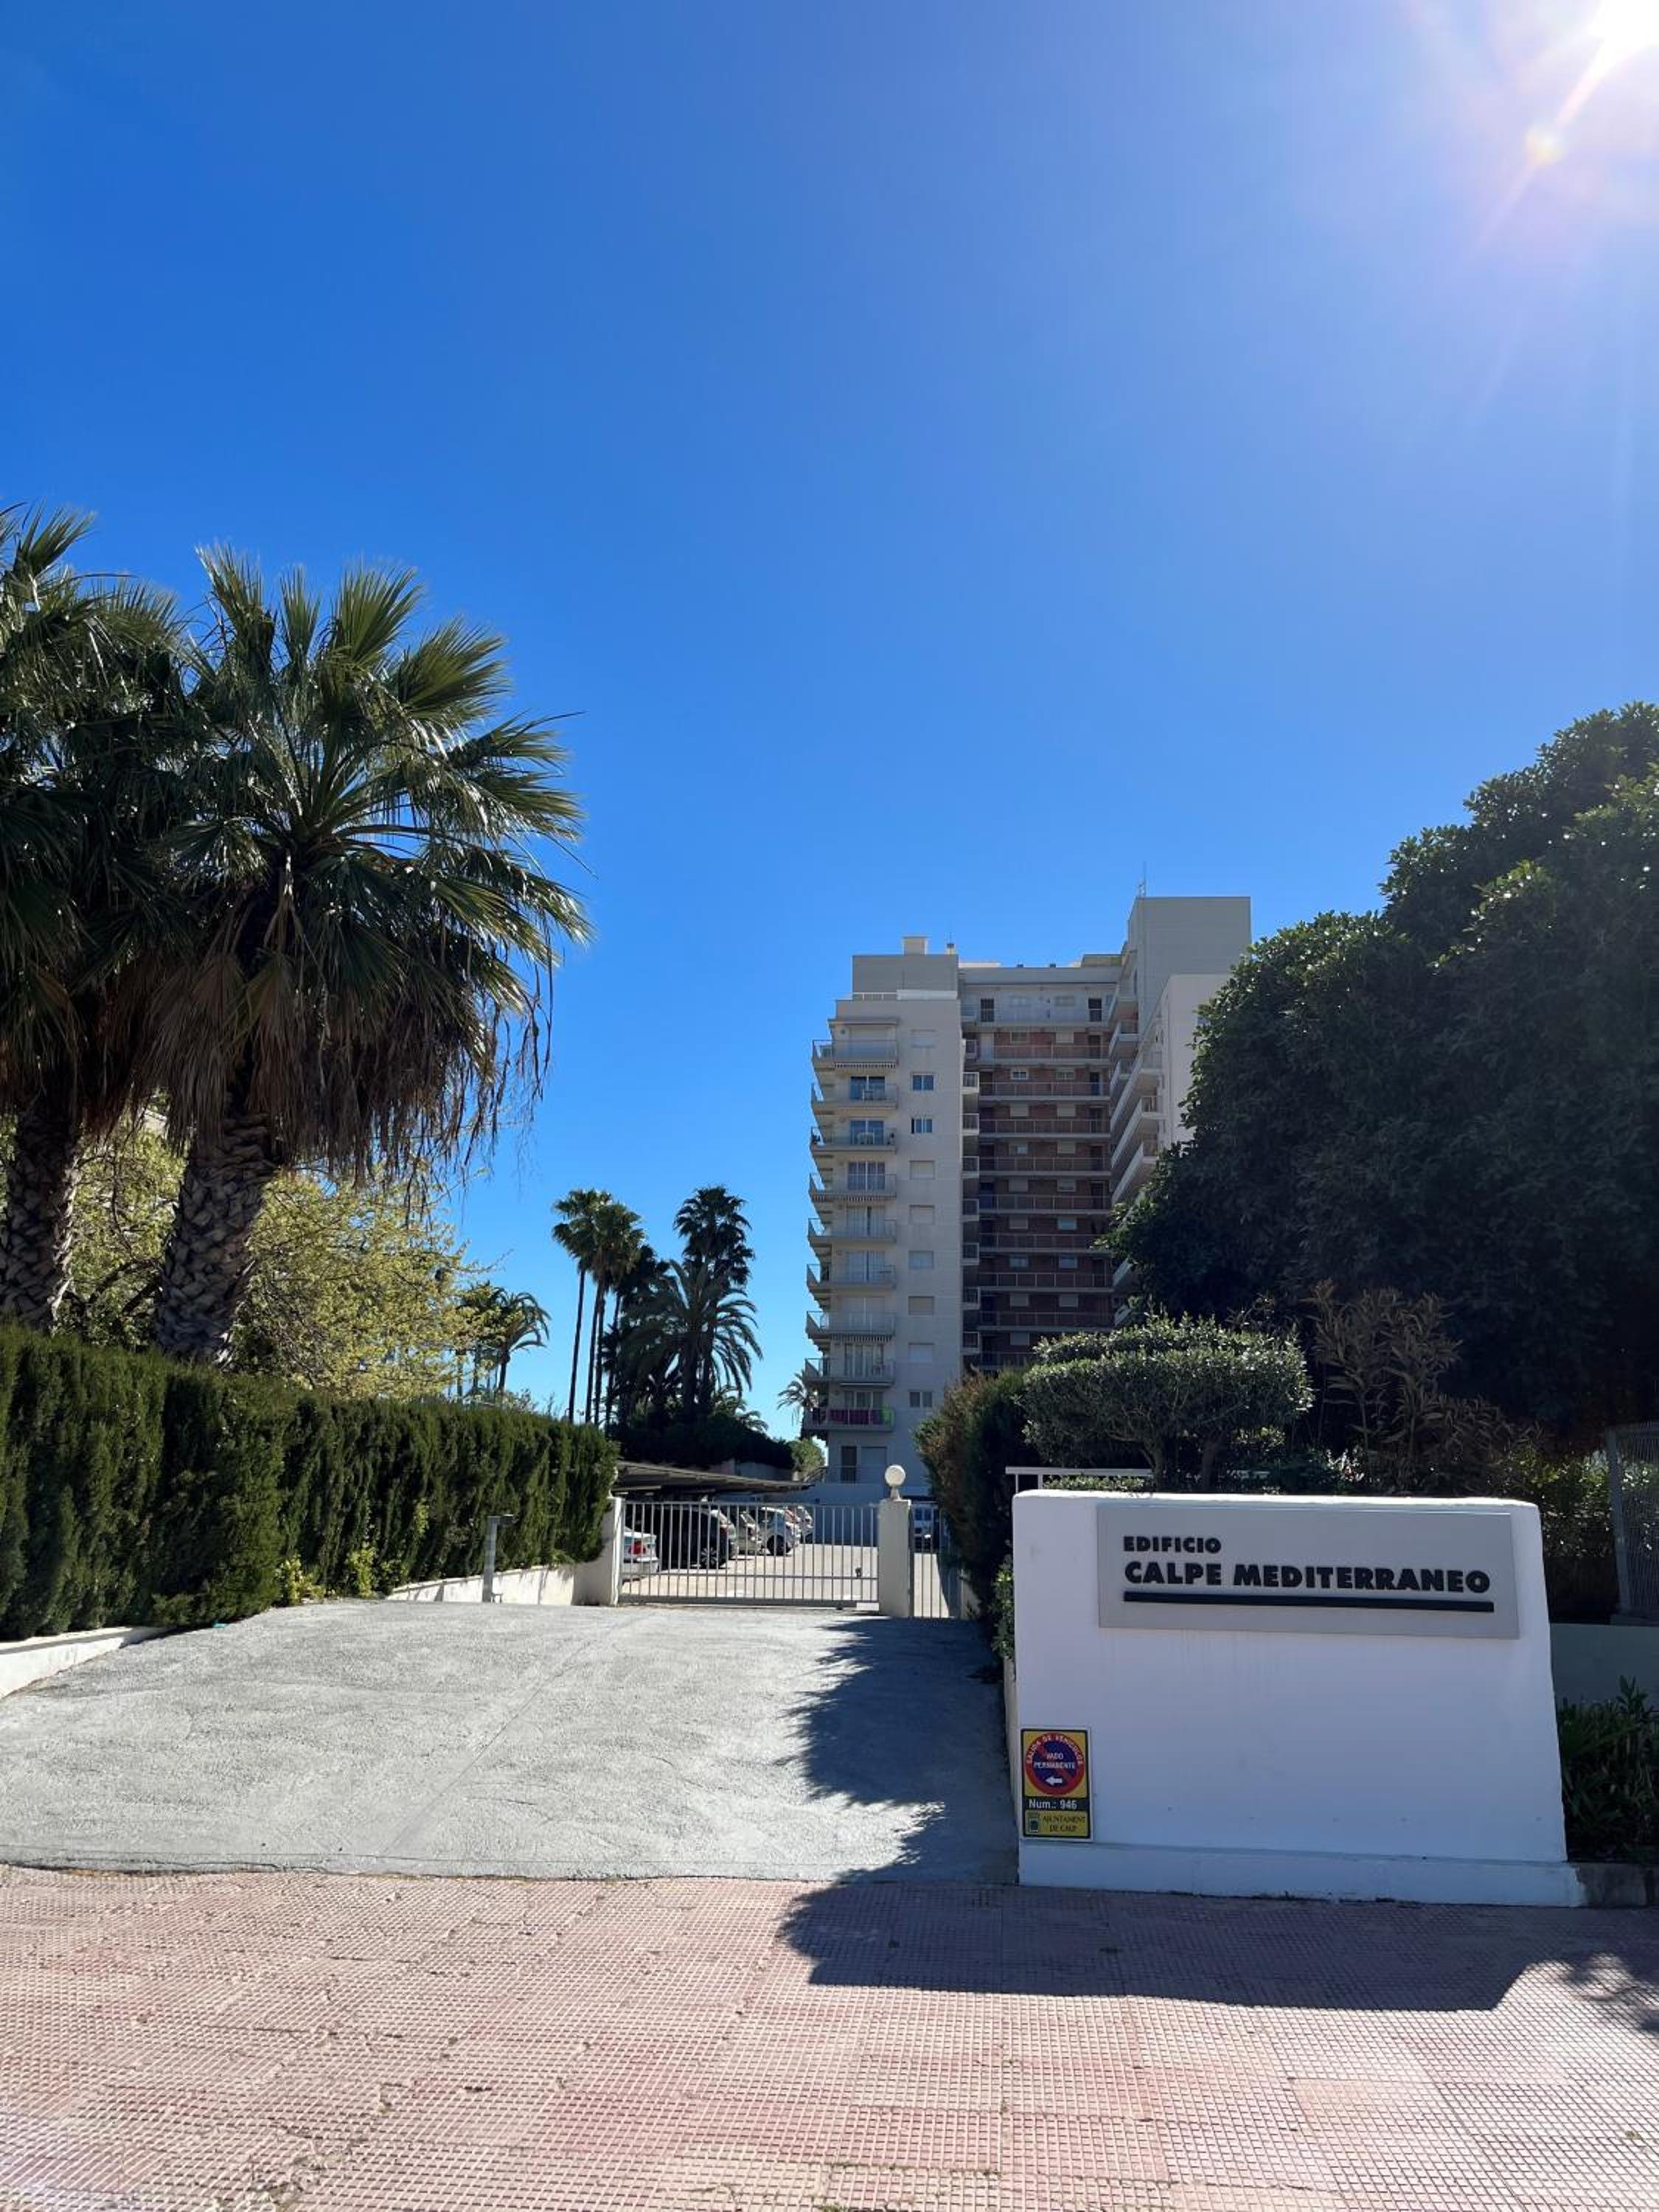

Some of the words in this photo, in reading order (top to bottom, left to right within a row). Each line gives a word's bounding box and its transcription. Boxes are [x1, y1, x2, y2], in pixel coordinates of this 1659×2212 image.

[1123, 1536, 1222, 1554] EDIFICIO
[1124, 1561, 1222, 1585] CALPE
[1233, 1563, 1491, 1594] MEDITERRANEO
[1034, 1761, 1076, 1769] PERMANENTE
[1060, 1799, 1077, 1809] 946
